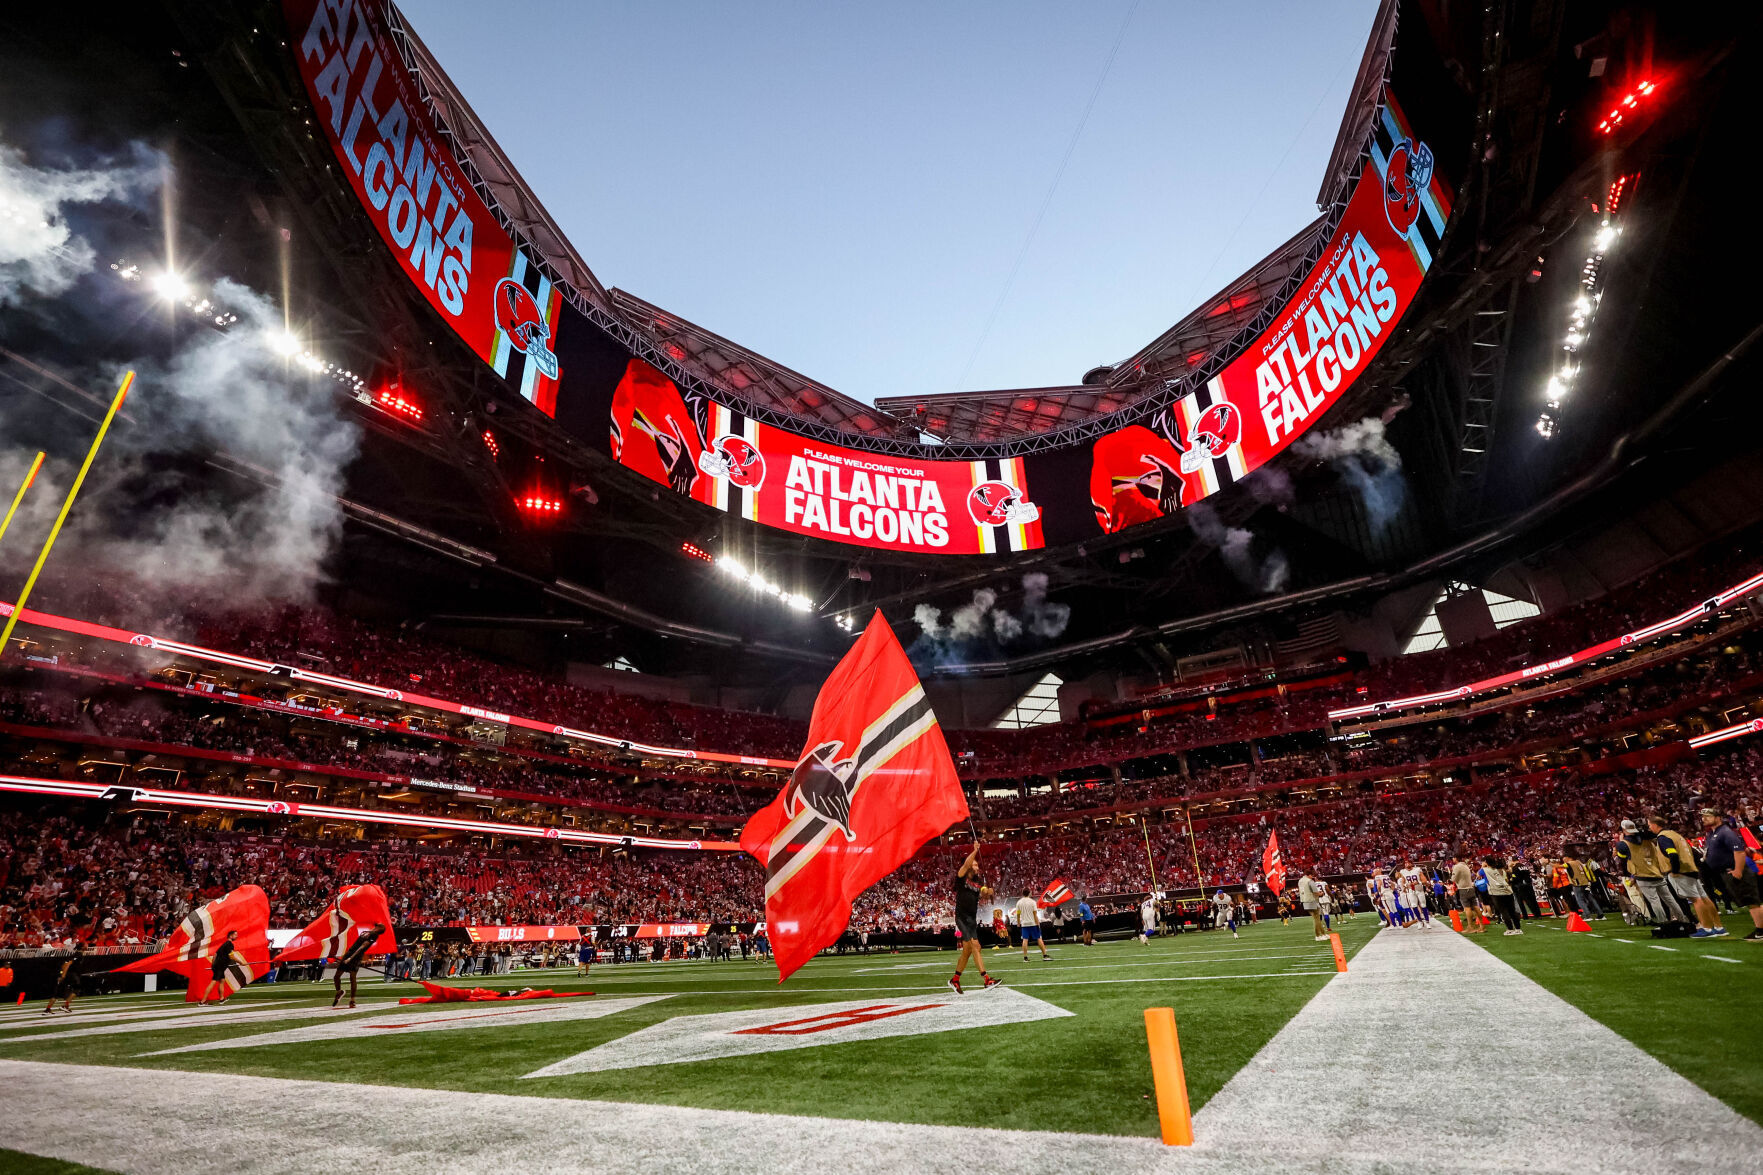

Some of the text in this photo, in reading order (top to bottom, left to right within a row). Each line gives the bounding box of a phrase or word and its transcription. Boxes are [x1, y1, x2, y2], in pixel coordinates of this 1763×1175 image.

[363, 0, 466, 203] EASE WELCOME YOUR
[301, 0, 469, 317] FALCONS
[1262, 232, 1350, 356] PLEASE WELCOME YOUR
[1255, 230, 1380, 409] ATLANTA
[1260, 267, 1397, 447] FALCONS
[785, 454, 947, 513] ATLANTA
[803, 447, 925, 478] PLEASE WELCOME YOUR
[785, 487, 950, 547] FALCONS
[460, 705, 485, 718] ATLANTA
[410, 777, 453, 790] Mercedes-Benz
[453, 783, 476, 793] Stadium
[1246, 883, 1260, 893] 25
[421, 931, 434, 941] 25
[497, 927, 554, 940] BILLS 0
[669, 925, 698, 936] FALCONS
